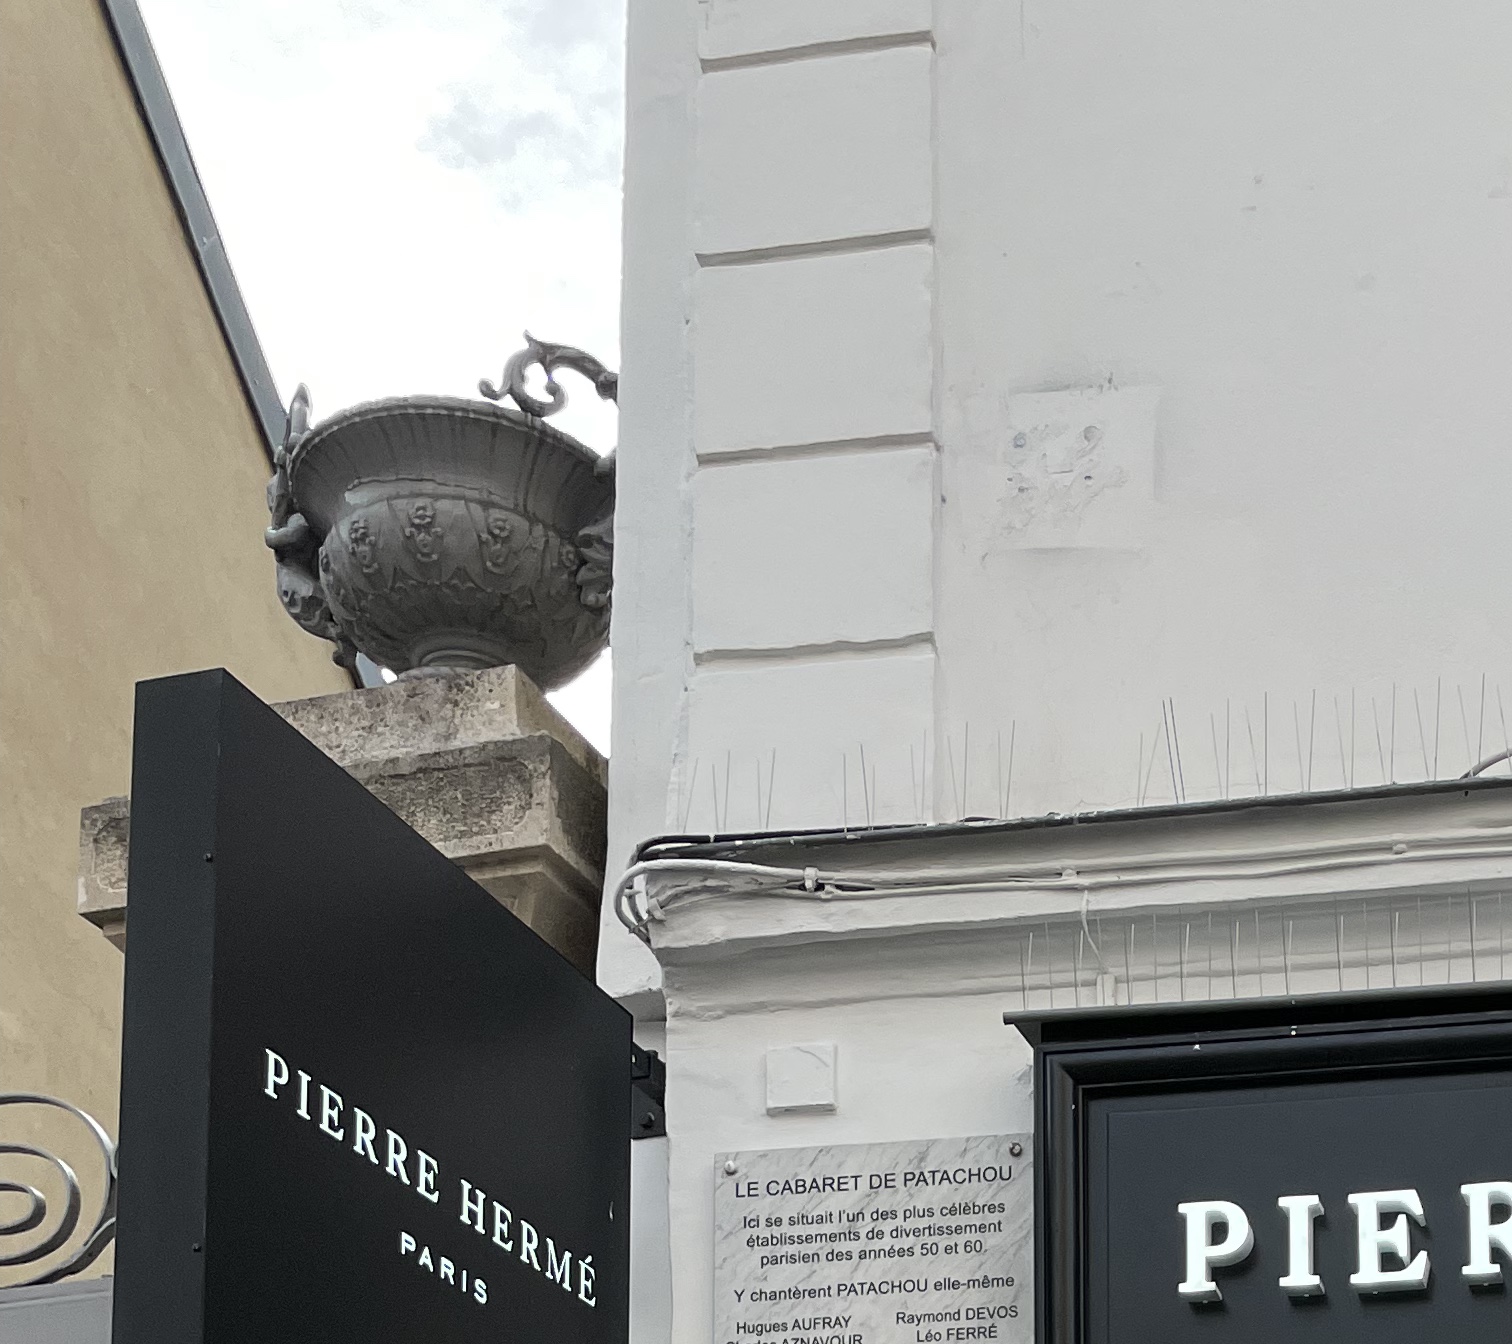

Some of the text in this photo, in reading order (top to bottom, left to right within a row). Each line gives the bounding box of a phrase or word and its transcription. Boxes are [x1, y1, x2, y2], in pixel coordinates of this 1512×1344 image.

[265, 1049, 596, 1307] PIERRE HERMÉ
[735, 1165, 1011, 1198] LE CABARET DE PATACHOU
[743, 1201, 1005, 1228] Ici se situait l'un des plus célèbres
[746, 1219, 1002, 1248] établissements de divertissement
[401, 1231, 488, 1304] PARIS
[760, 1250, 820, 1269] parisien
[825, 1248, 852, 1261] des
[858, 1244, 914, 1260] années
[920, 1242, 938, 1256] 50
[944, 1241, 958, 1254] et
[733, 1274, 1014, 1302] Y chantèrent PATACHOU elle-même
[736, 1315, 851, 1336] Hugues AUFRAY
[895, 1304, 1018, 1326] Raymond DEVOS
[916, 1322, 997, 1342] Léo FERRÉ
